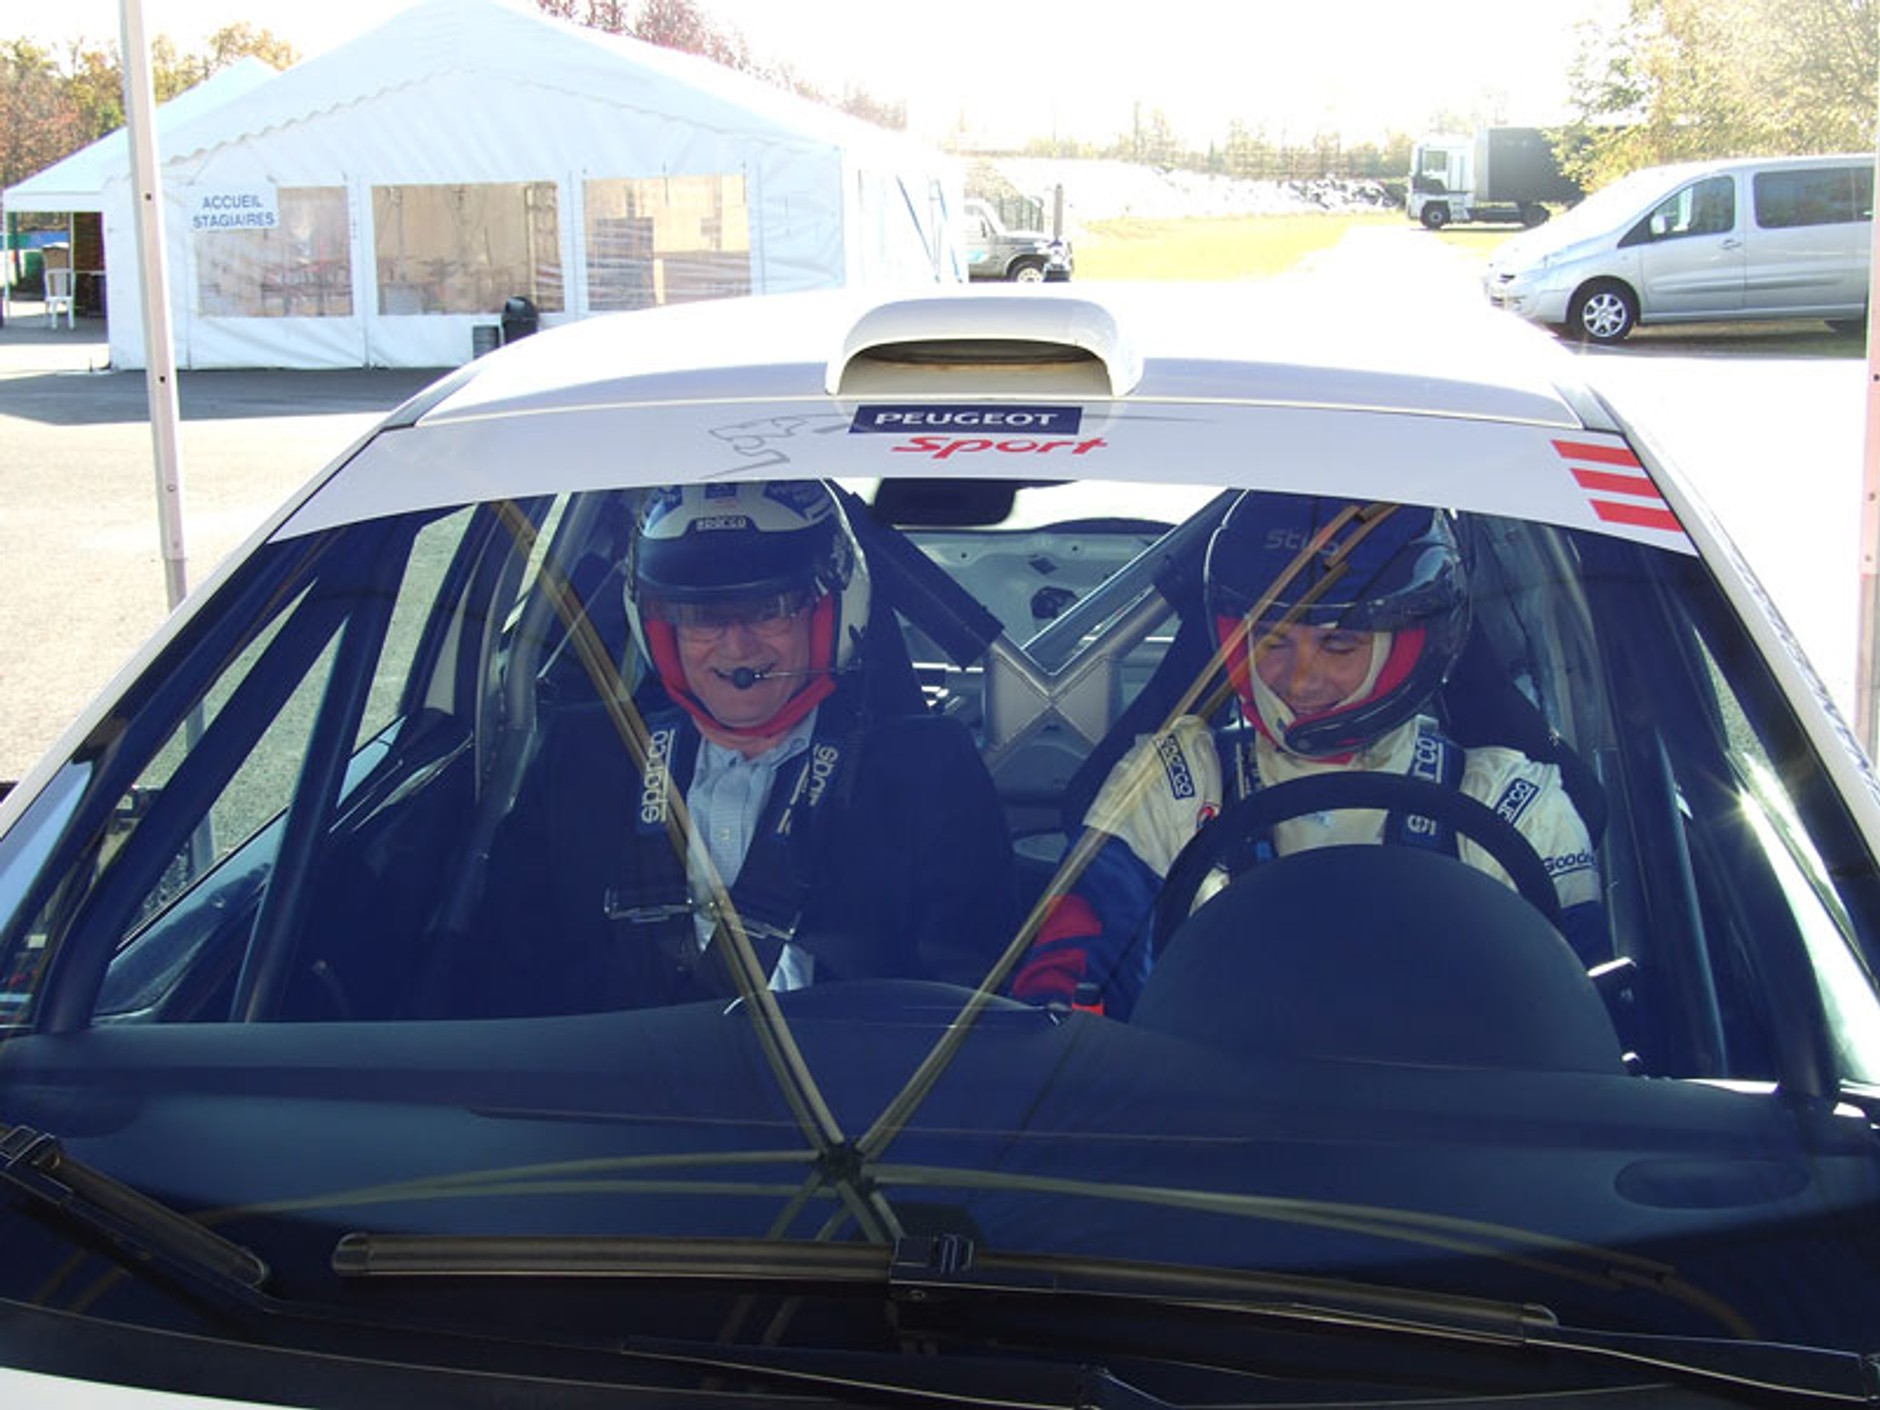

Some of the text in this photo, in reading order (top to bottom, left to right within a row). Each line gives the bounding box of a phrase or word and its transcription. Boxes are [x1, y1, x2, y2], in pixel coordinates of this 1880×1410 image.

[202, 194, 264, 210] ACCUEIL
[193, 212, 276, 229] STAGIAIRES
[875, 412, 1058, 427] PEUGEOT
[891, 436, 1108, 459] Sport
[641, 729, 675, 824] sparco
